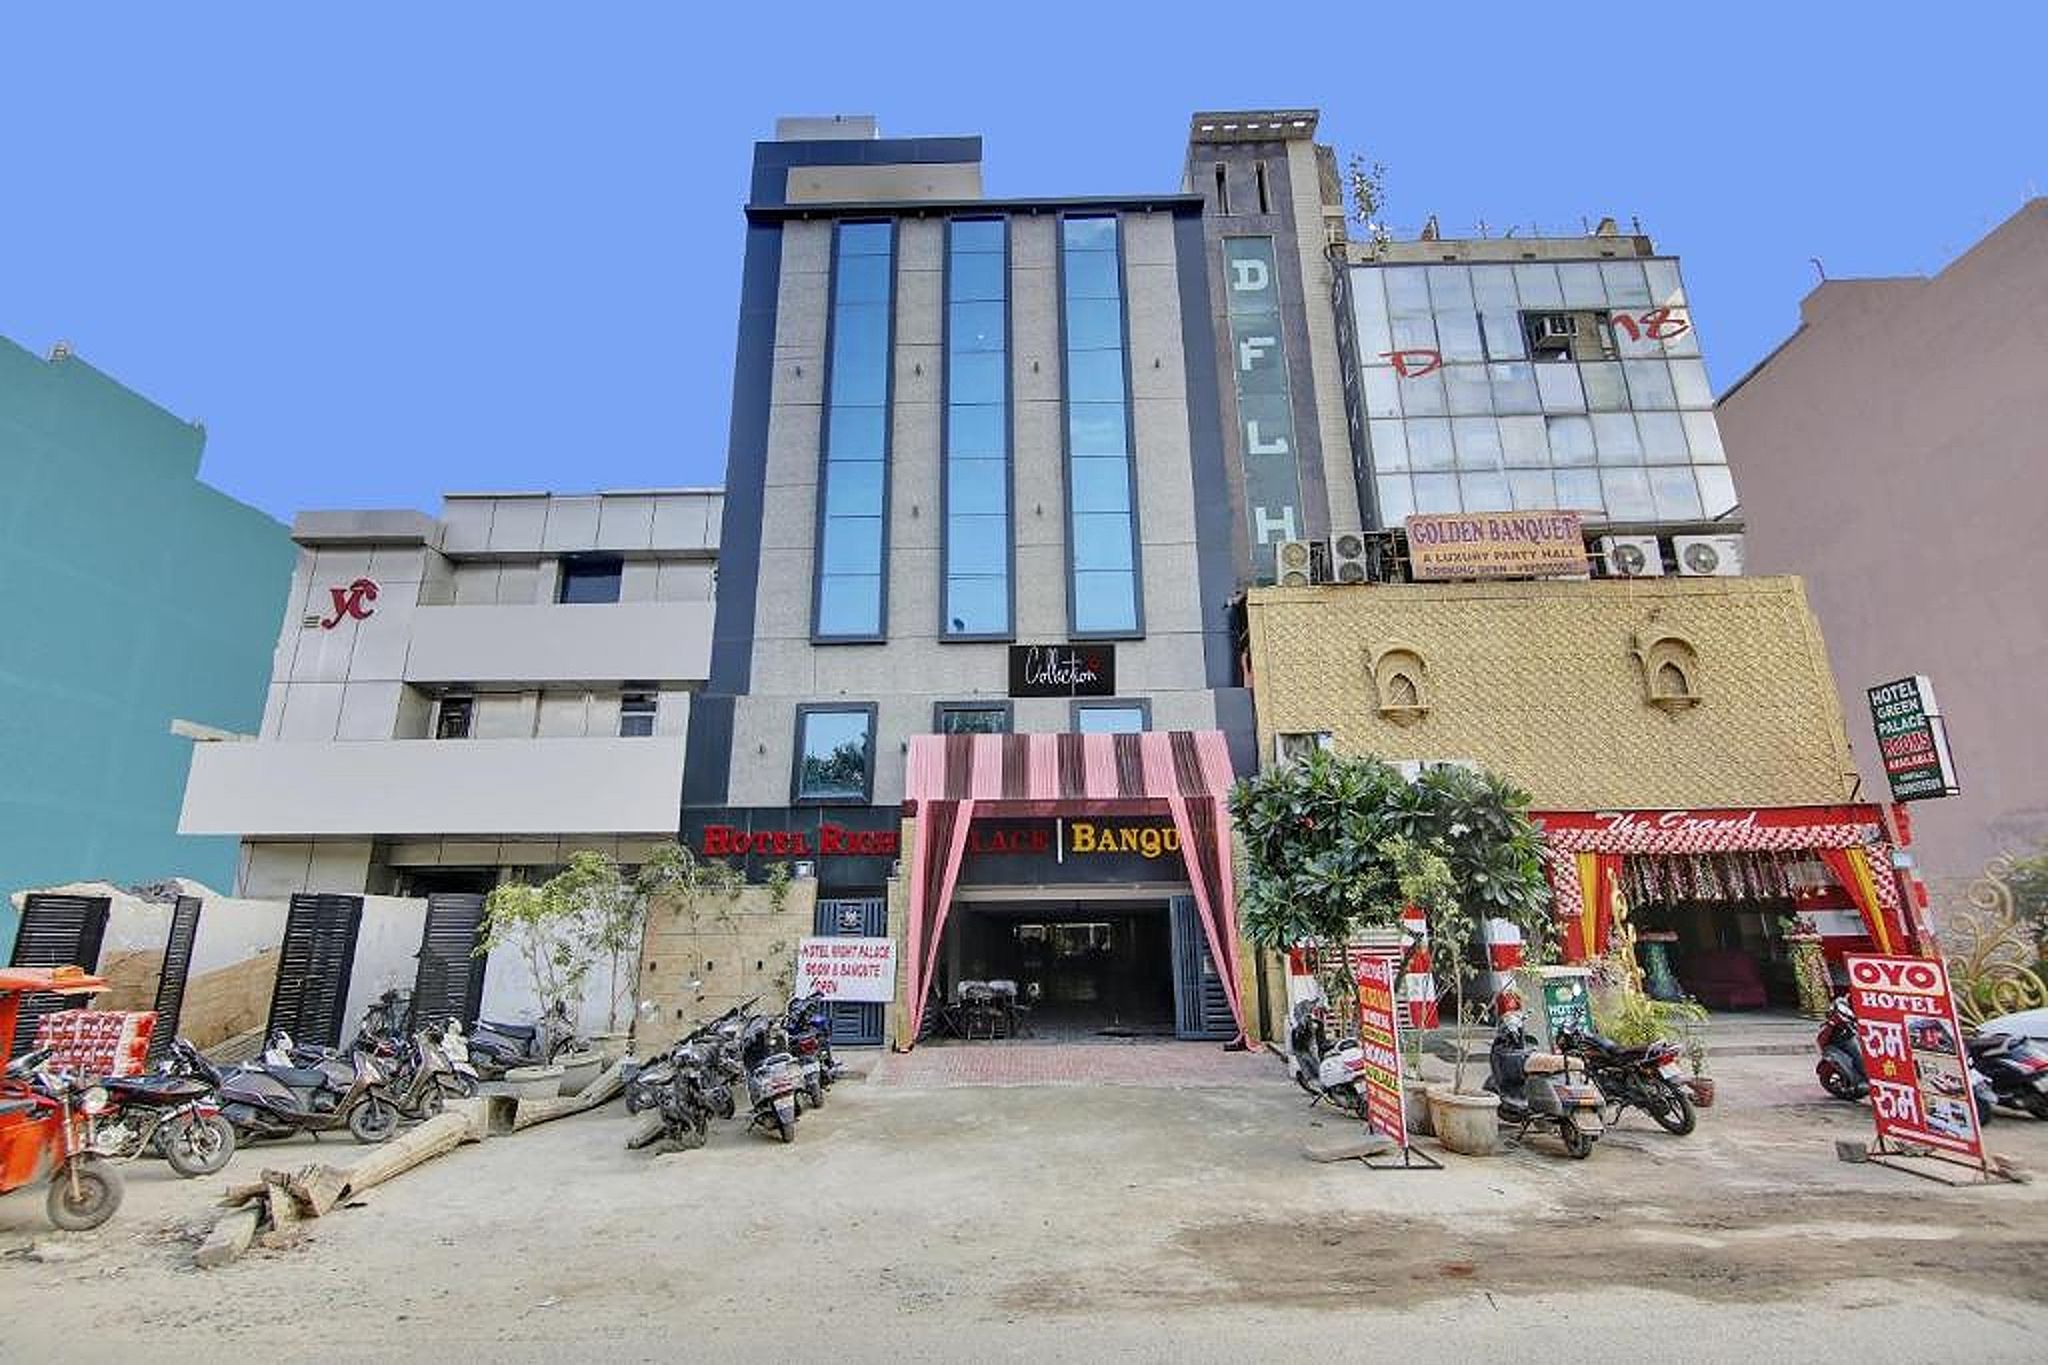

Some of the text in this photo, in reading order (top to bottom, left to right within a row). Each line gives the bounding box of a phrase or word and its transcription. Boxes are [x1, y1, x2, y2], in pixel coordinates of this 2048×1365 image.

[1413, 515, 1577, 545] GOLDEN BANQUET
[1435, 551, 1489, 563] LUXURY
[1494, 551, 1537, 562] PARTY
[1541, 549, 1576, 560] HALL
[1025, 645, 1098, 696] Collection
[1871, 681, 1918, 707] HOTEL
[1877, 698, 1919, 719] GREEN
[1879, 713, 1927, 735] PALACE
[1883, 731, 1932, 755] ROOMS
[1888, 751, 1937, 770] AVAILABLE
[1595, 812, 1650, 832] The
[1072, 822, 1182, 858] BANQU
[1853, 962, 1936, 990] OYO
[1861, 992, 1943, 1015] HOTEL
